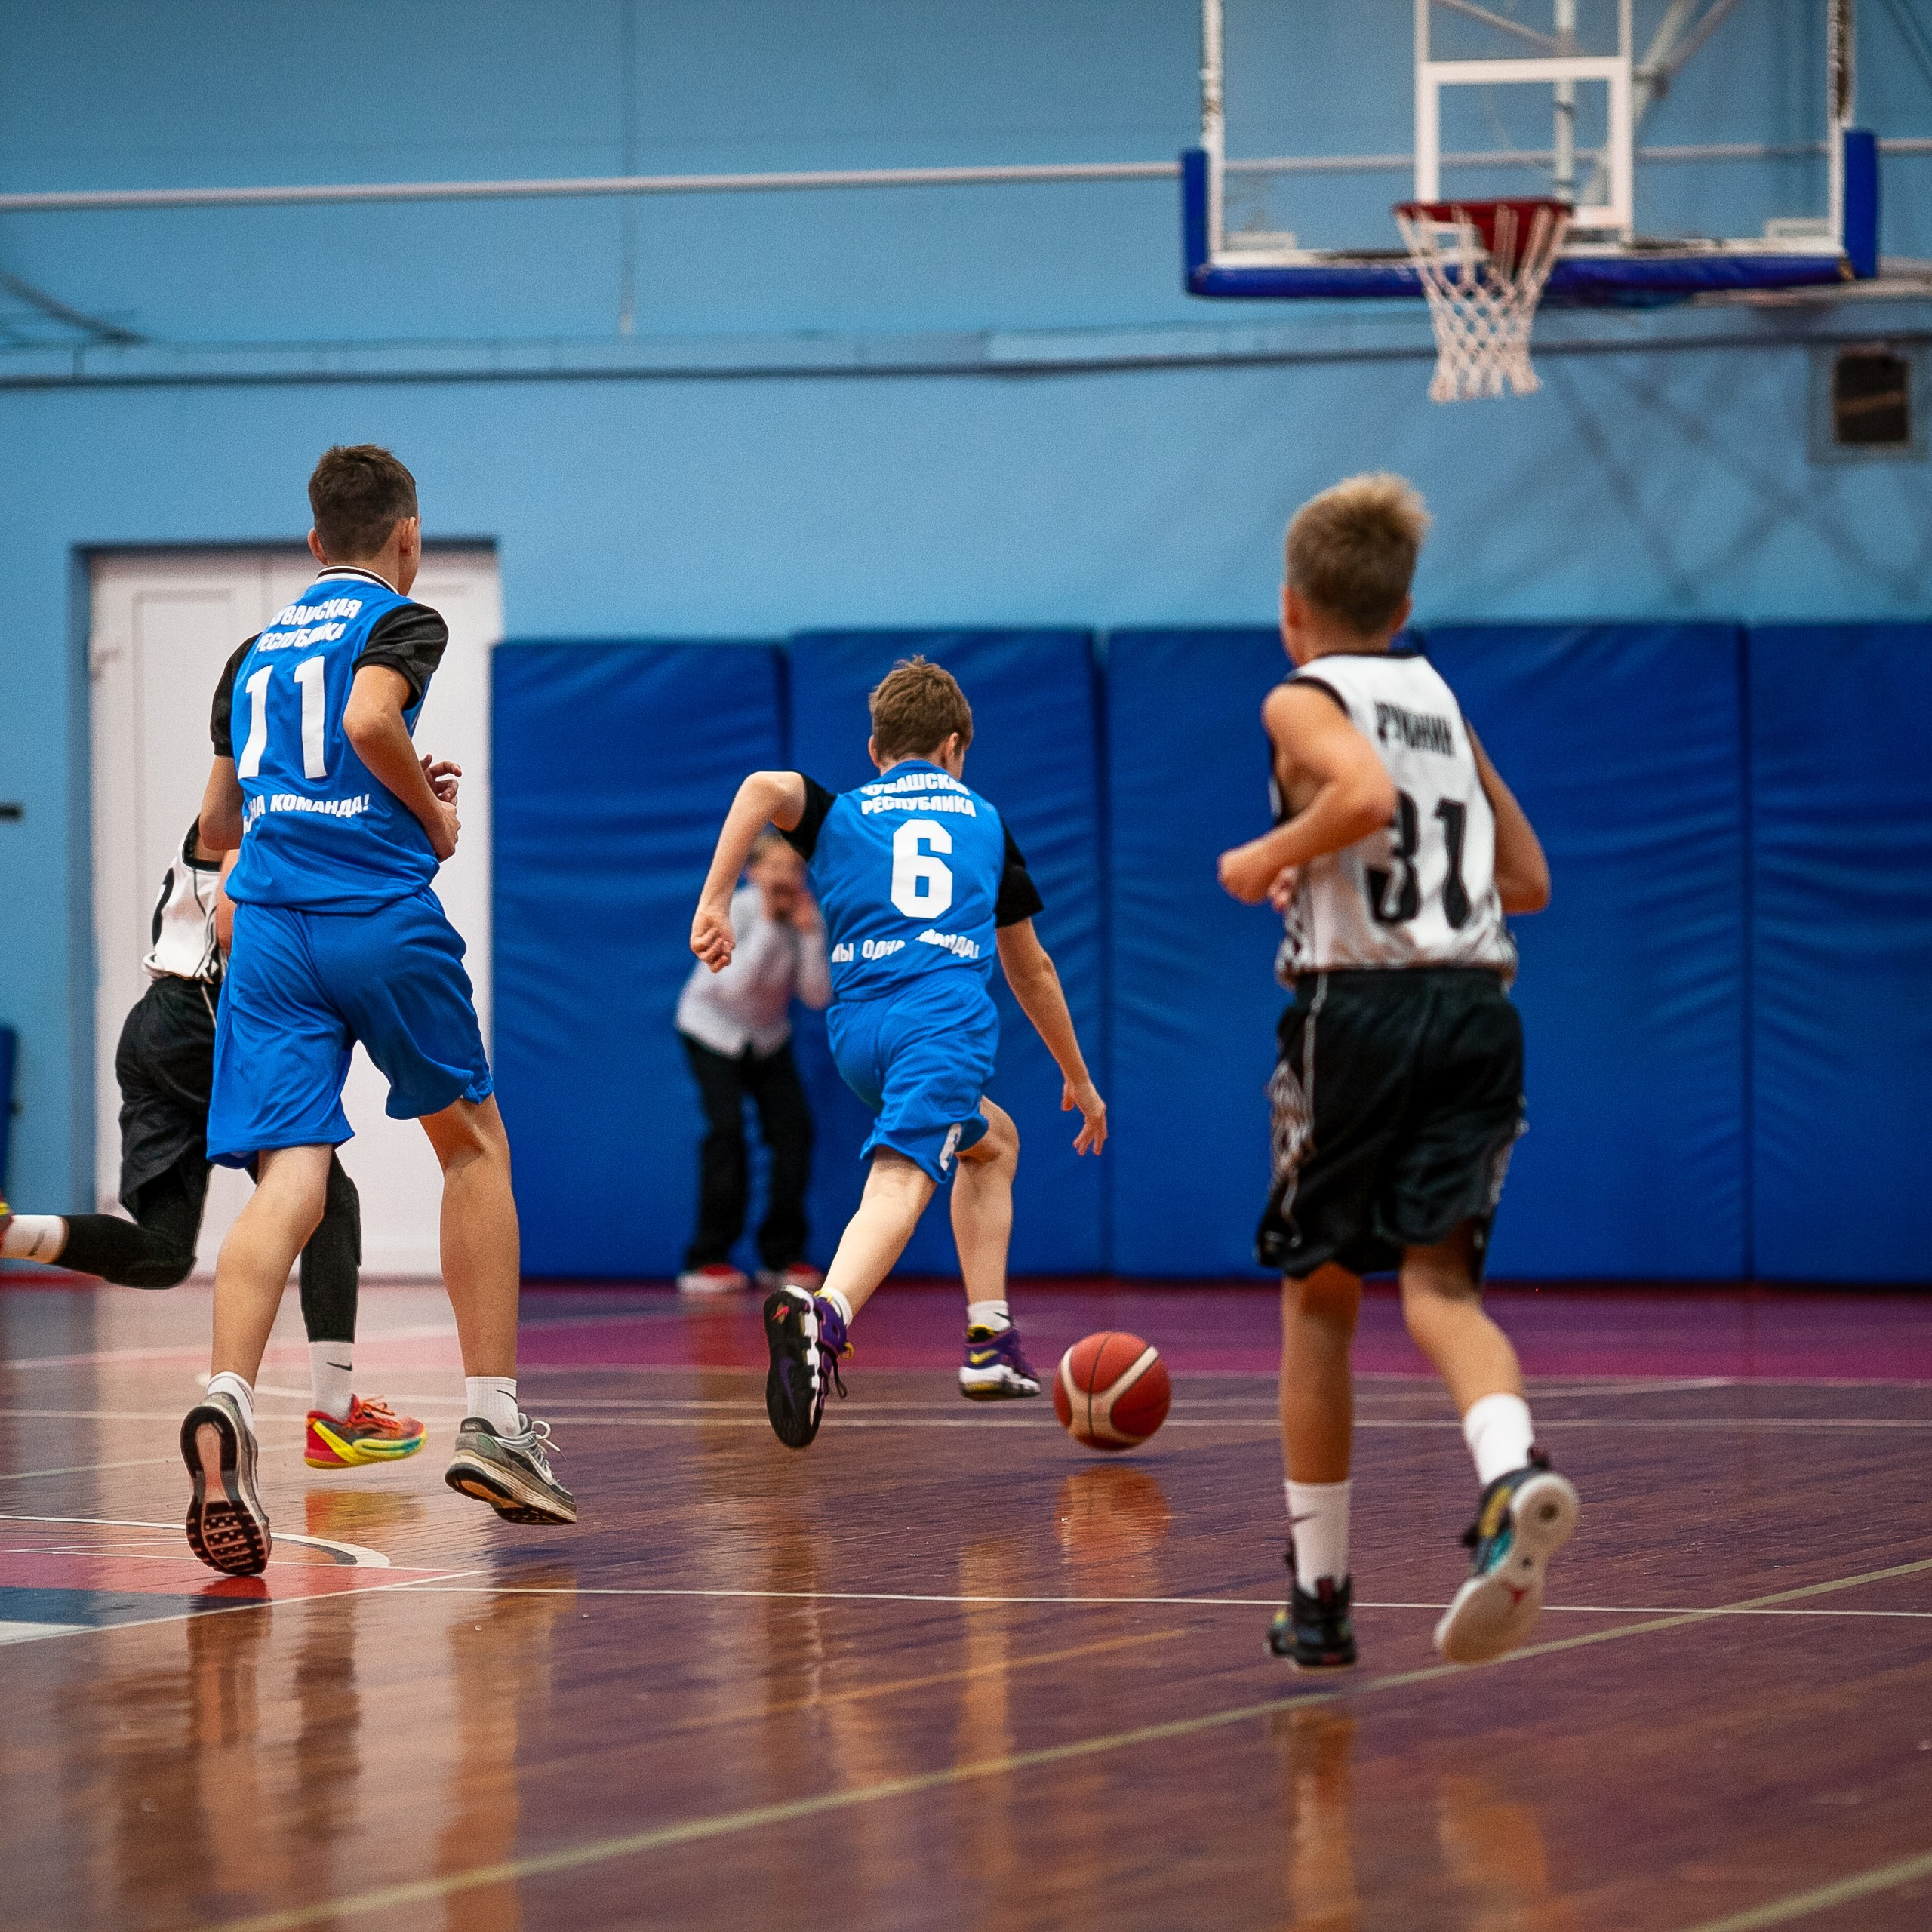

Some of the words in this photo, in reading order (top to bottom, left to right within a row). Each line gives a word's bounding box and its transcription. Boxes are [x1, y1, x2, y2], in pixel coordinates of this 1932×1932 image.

[238, 656, 327, 780] 11
[270, 794, 370, 817] КОМАНДА!
[861, 795, 977, 817] РЕСПУБЛИКА
[891, 819, 952, 918] 6
[1367, 790, 1471, 928] 31
